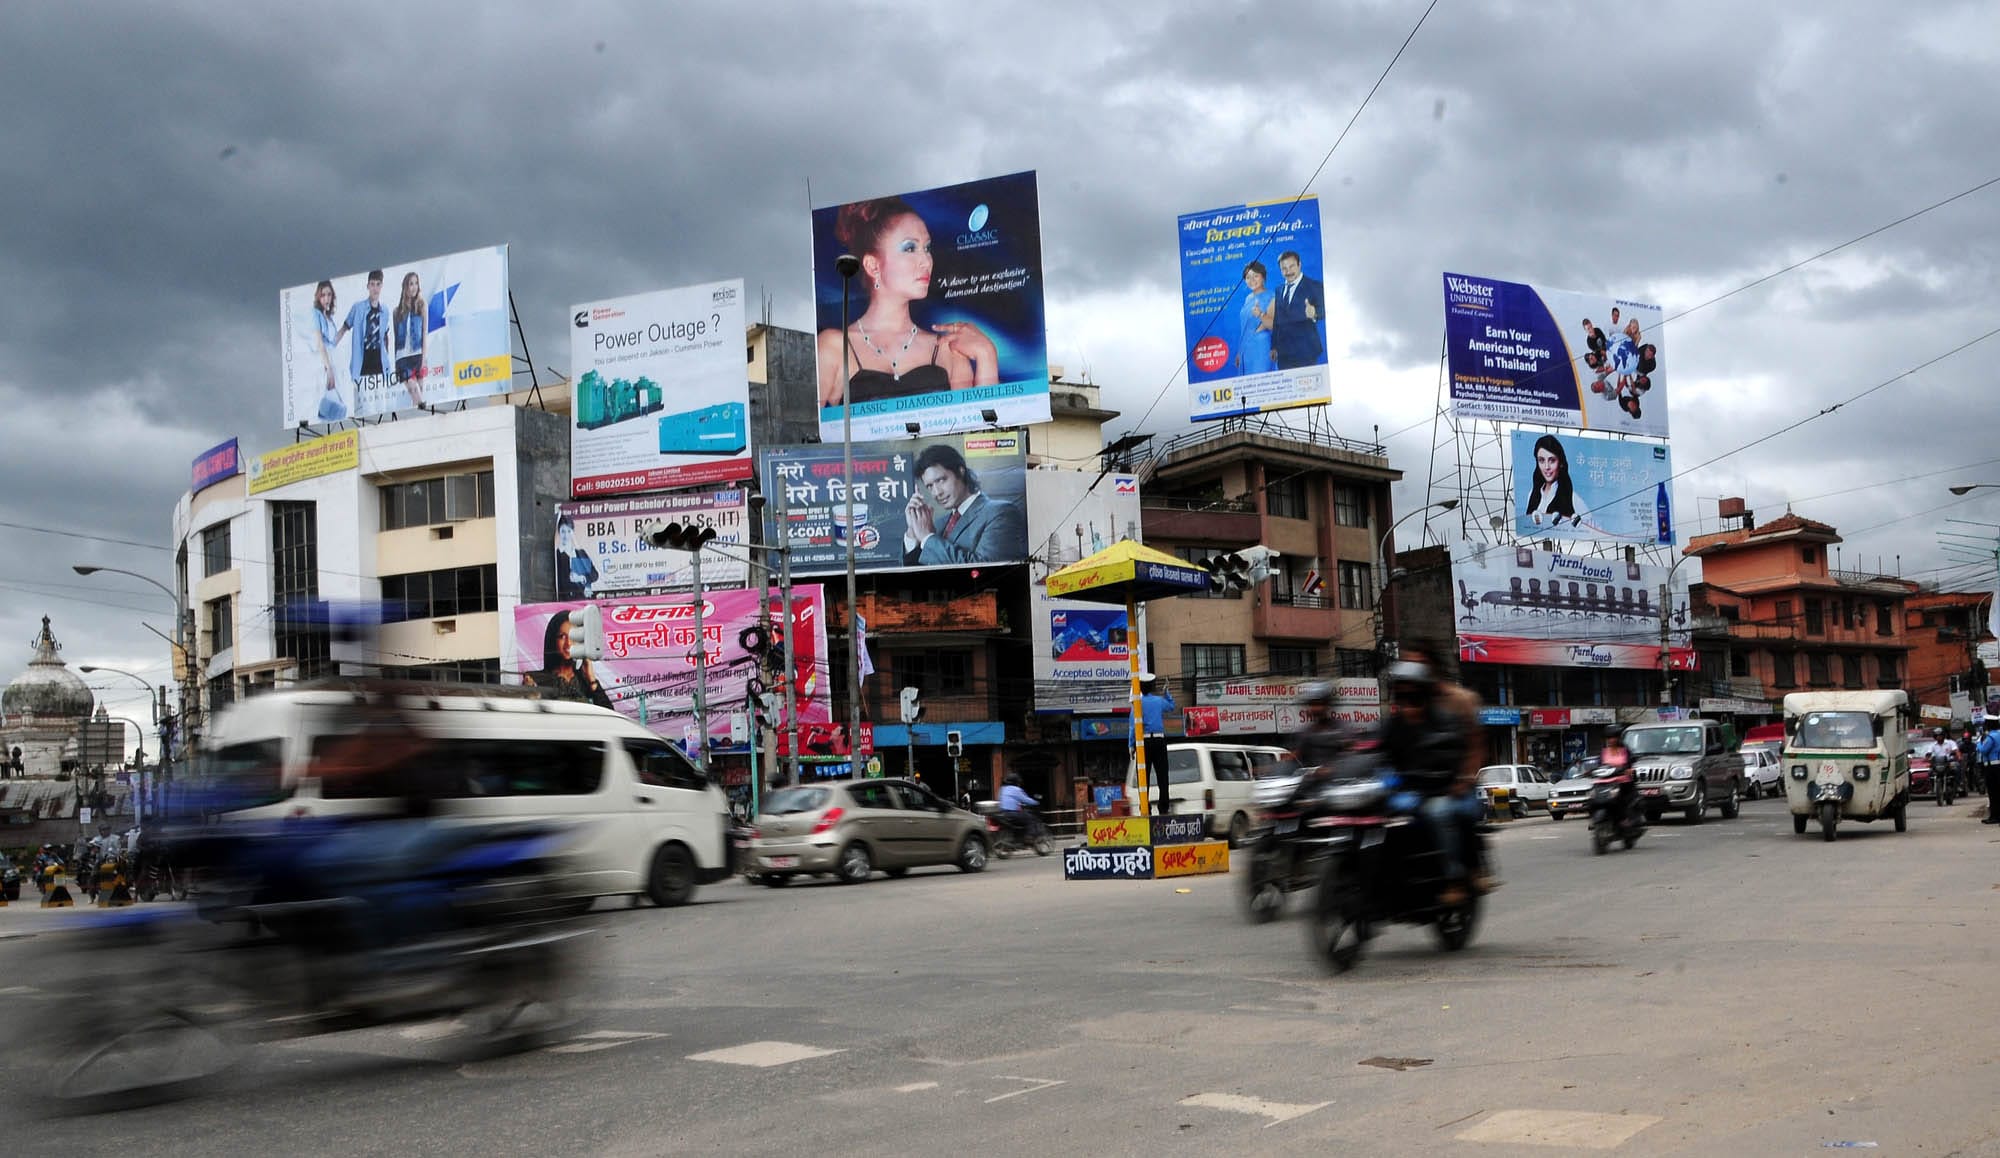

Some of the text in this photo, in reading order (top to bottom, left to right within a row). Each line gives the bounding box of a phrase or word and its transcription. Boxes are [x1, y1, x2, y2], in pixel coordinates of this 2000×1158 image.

[957, 229, 999, 245] CLASSIC
[950, 276, 968, 286] door
[971, 275, 978, 285] to
[980, 274, 990, 282] an
[992, 267, 1026, 281] exclusive
[945, 284, 979, 299] diamond
[1447, 277, 1494, 298] Webster
[1450, 293, 1494, 307] UNIVERSITY
[594, 313, 721, 353] Power Outage ?
[1485, 325, 1532, 342] Earn Your
[1469, 338, 1550, 360] American Degree
[458, 364, 482, 380] ufo
[1484, 355, 1537, 373] in Thailand
[848, 401, 888, 417] LASSIC
[896, 394, 953, 410] DIAMOND
[962, 385, 1024, 401] JEWELLERS
[1213, 387, 1232, 403] LIC
[1456, 401, 1482, 410] Contact:
[1521, 406, 1533, 415] and
[776, 463, 806, 480] मेरो
[576, 484, 594, 492] Call:
[595, 475, 645, 489] 9802025100
[580, 505, 590, 515] Go
[592, 504, 602, 513] for
[604, 502, 628, 513] Power
[630, 498, 671, 510] Bachelor's
[673, 497, 700, 507] Degree
[587, 521, 616, 537] BBA
[600, 540, 630, 555] B.Sc.
[607, 623, 669, 658] सुन्दरी
[1111, 645, 1127, 654] VISA
[1053, 669, 1130, 680] Accepted Globally
[1226, 684, 1252, 695] NABIL
[1255, 686, 1286, 695] SAVING
[1331, 686, 1378, 697] O-OPERATIVE
[1165, 818, 1200, 839] ट्राफिक प्रहरी
[1066, 847, 1151, 876] ट्राफिक प्रहरी
